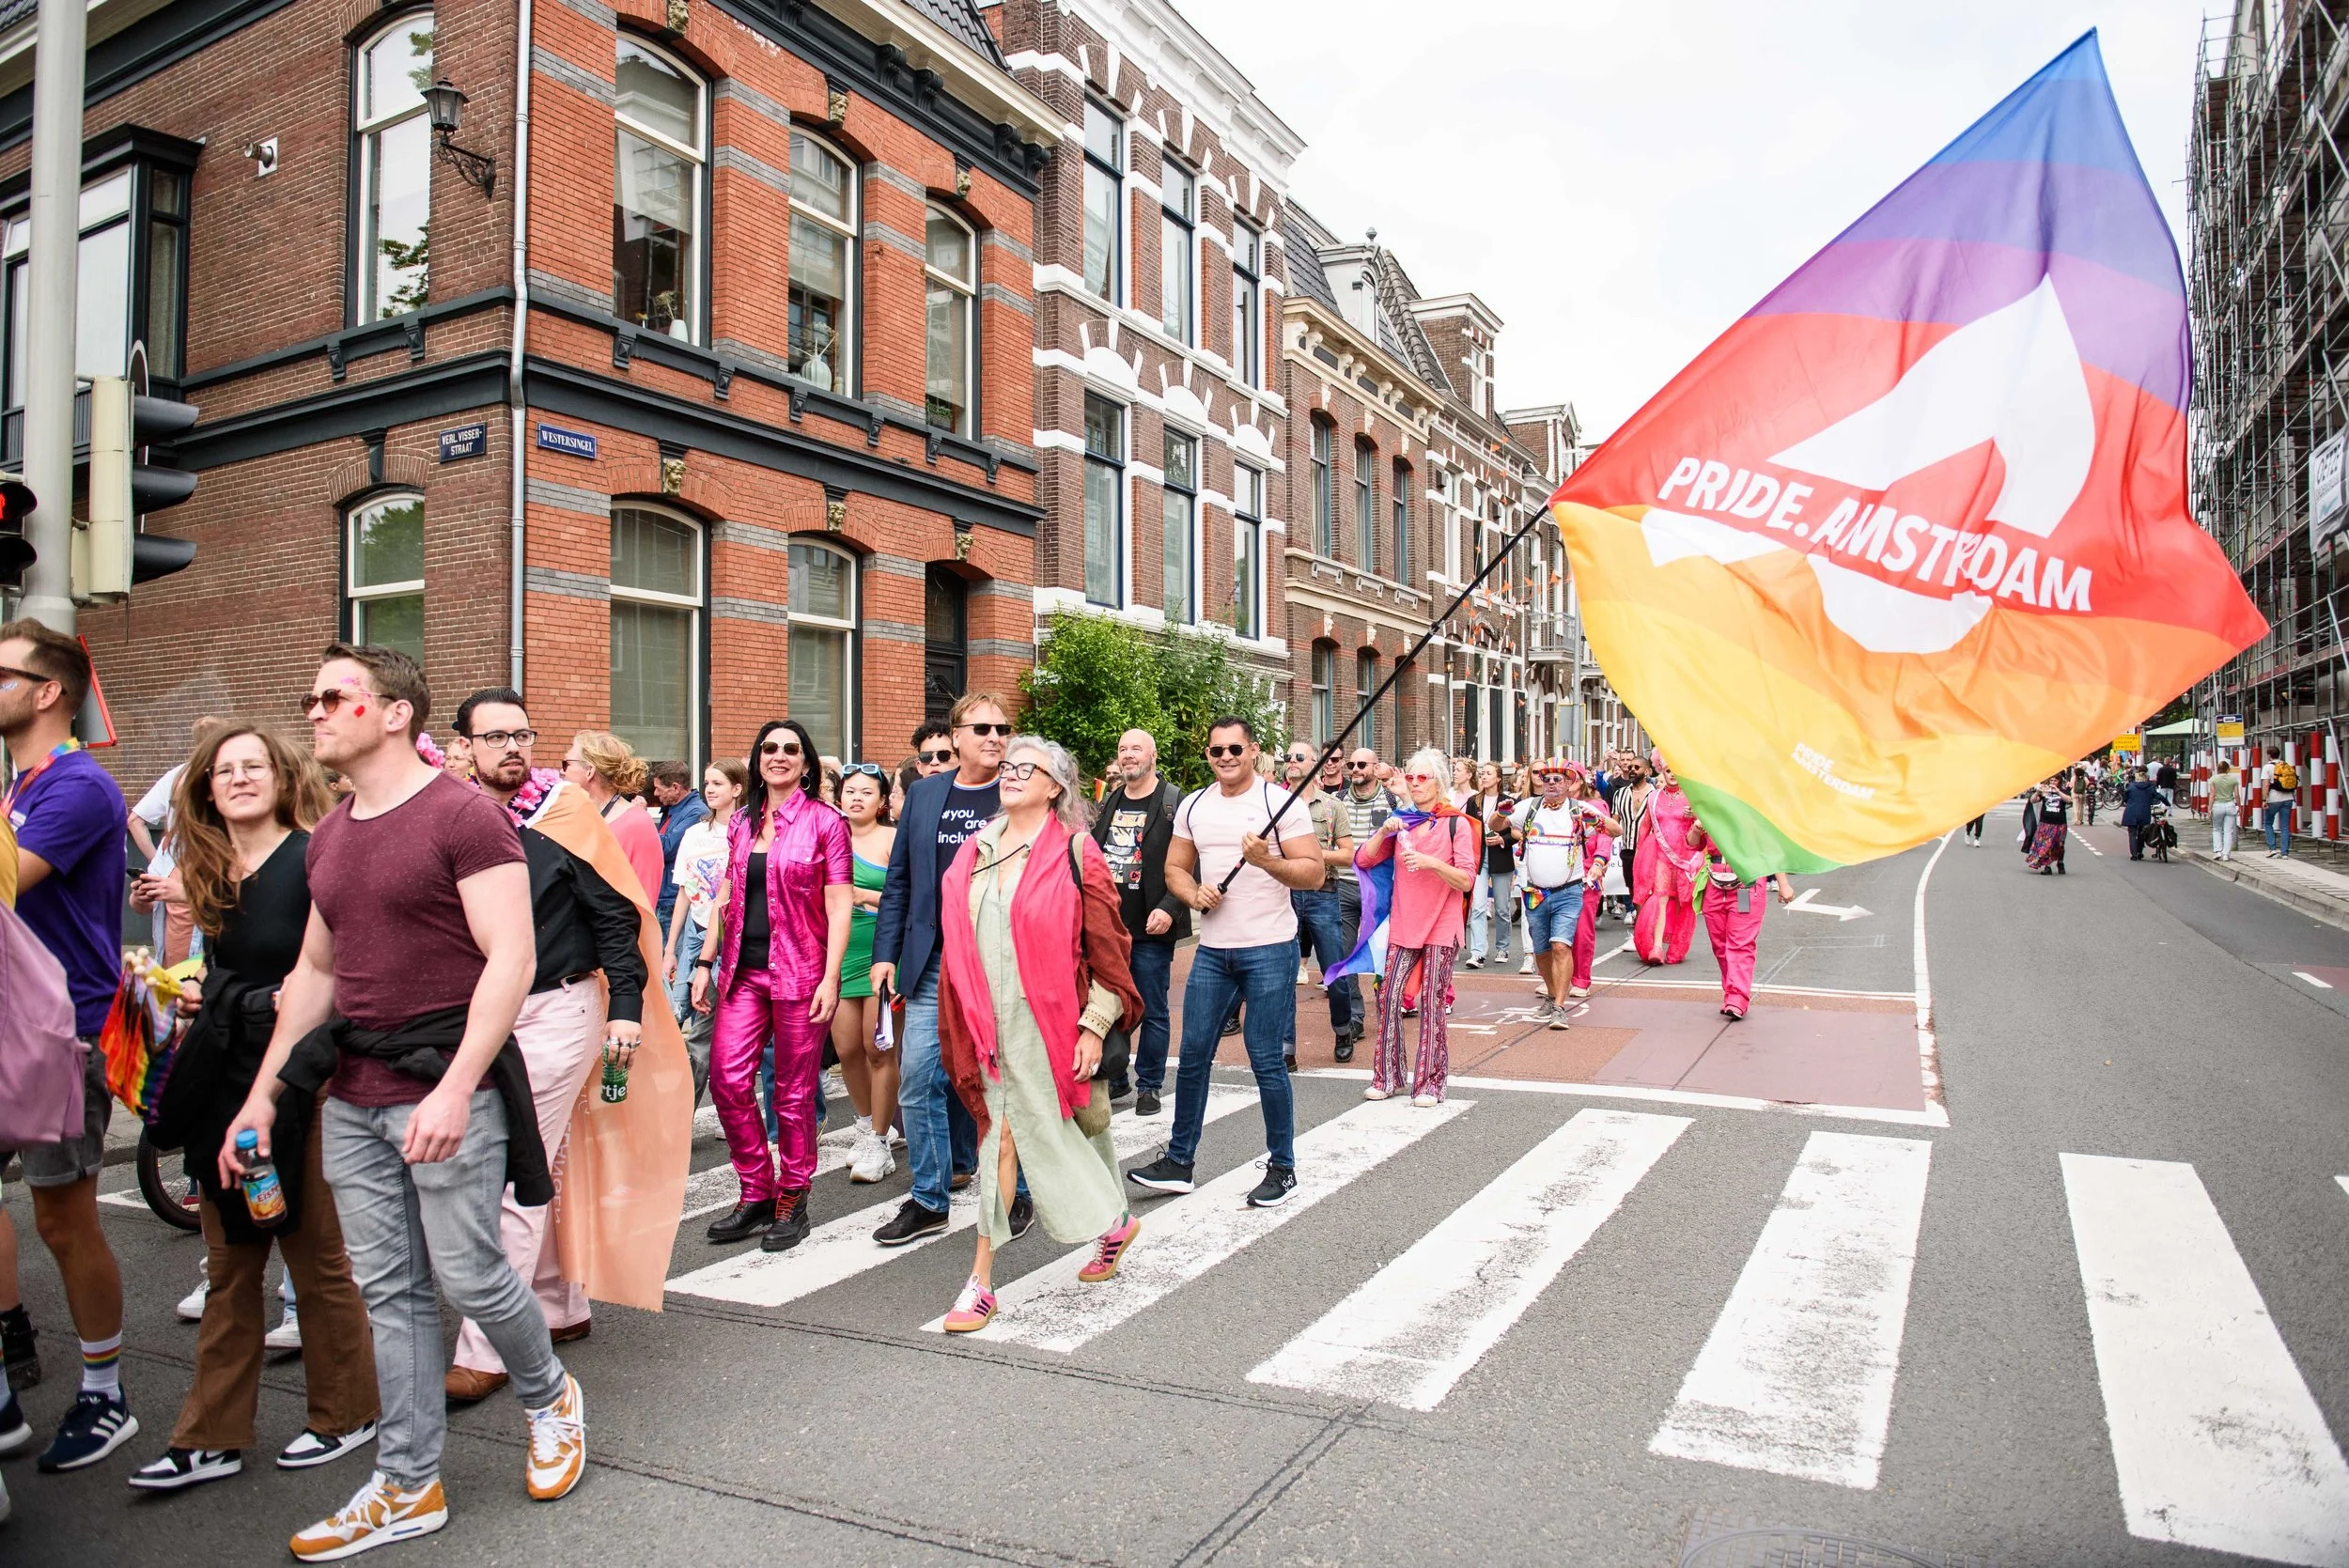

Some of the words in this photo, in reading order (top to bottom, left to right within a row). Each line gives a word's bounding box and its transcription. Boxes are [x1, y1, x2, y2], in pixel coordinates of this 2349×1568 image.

[459, 428, 482, 442] VISSER-
[541, 430, 593, 453] WESTERSINGEL
[451, 442, 473, 456] STRAAT
[1794, 741, 1834, 770] PRIDE
[1790, 753, 1875, 800] AMSTERDAM
[941, 809, 974, 821] #you
[964, 819, 987, 830] are
[938, 831, 975, 844] inclu
